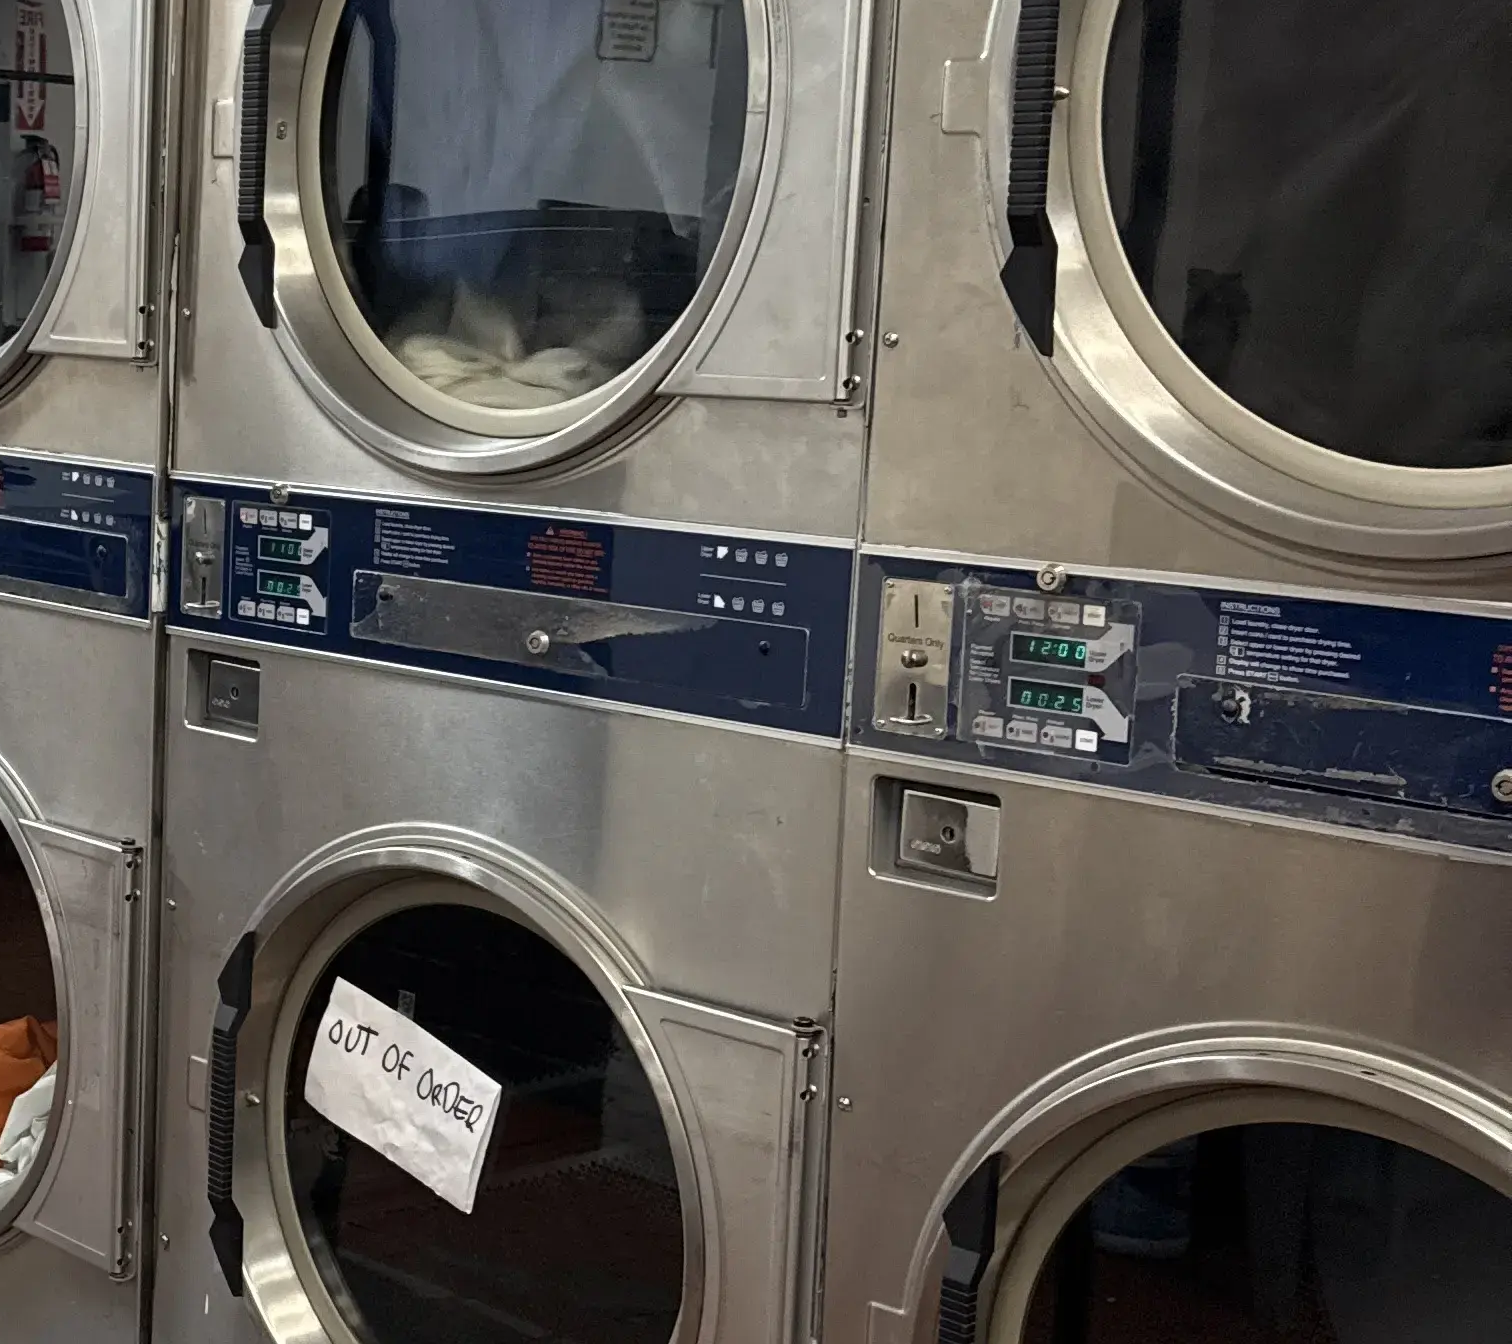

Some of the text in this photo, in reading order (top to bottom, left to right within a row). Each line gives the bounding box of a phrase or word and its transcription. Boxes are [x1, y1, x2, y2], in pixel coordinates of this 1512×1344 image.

[328, 1019, 484, 1133] OUT OF ORDER
